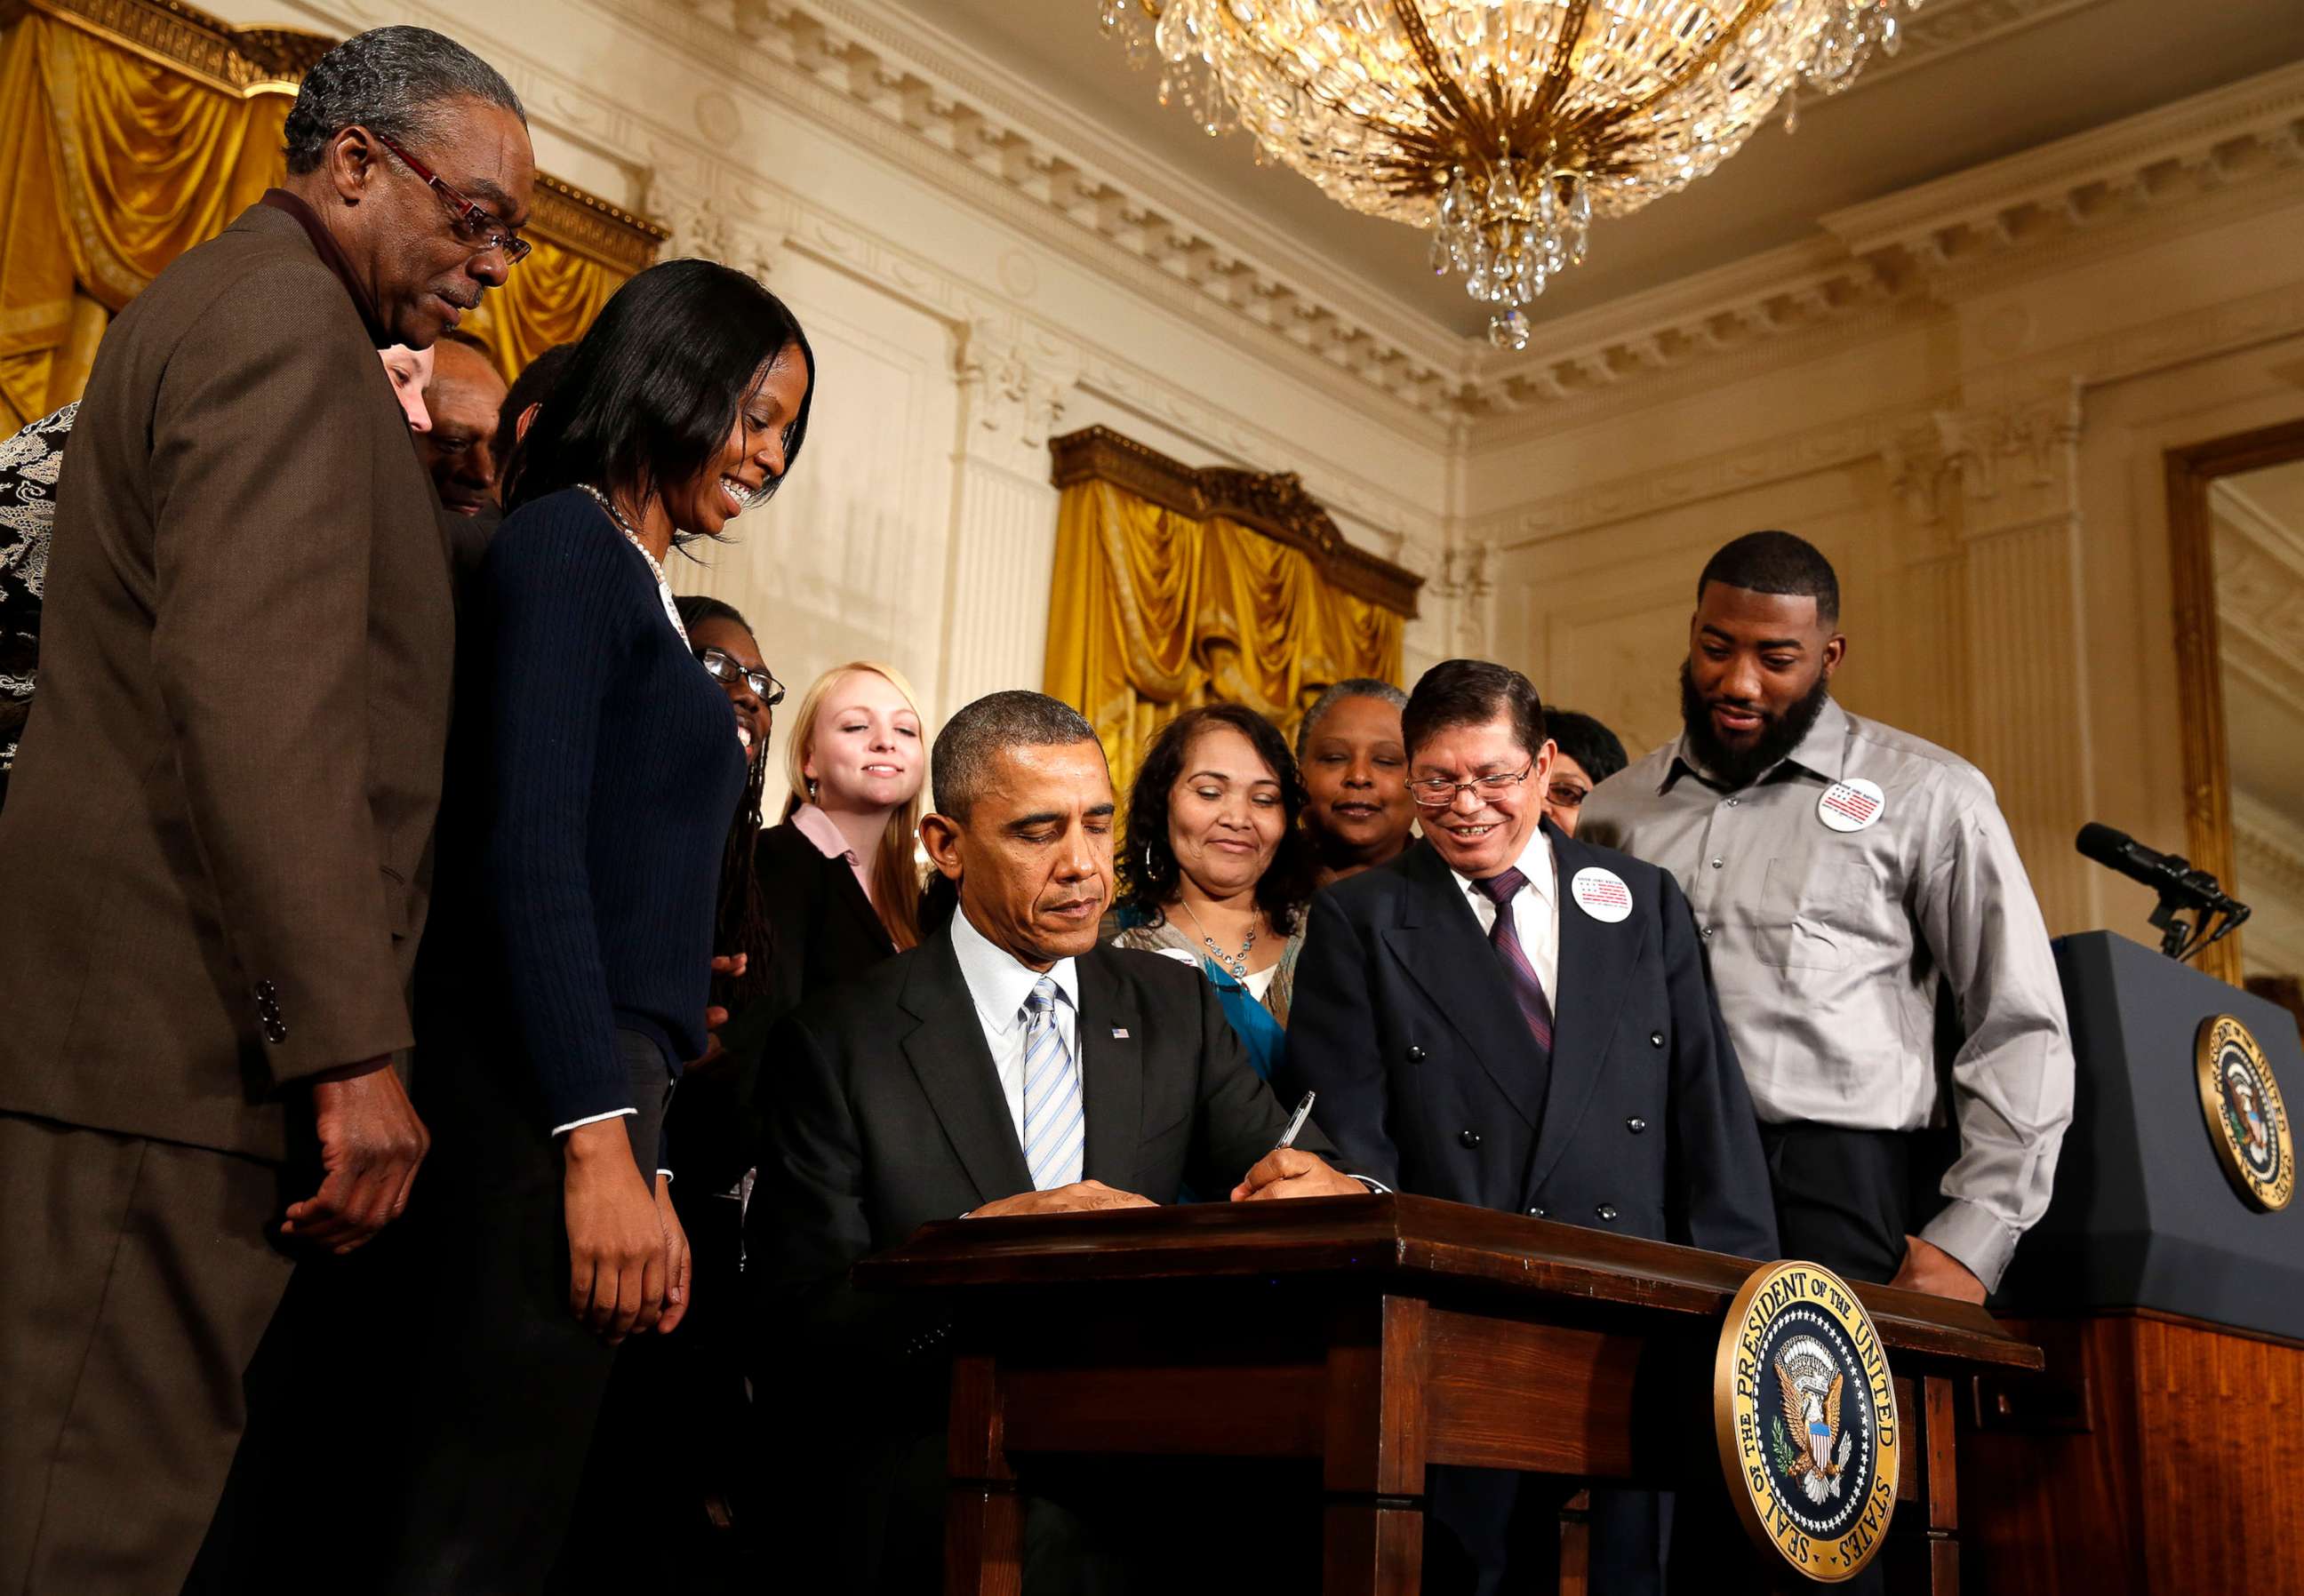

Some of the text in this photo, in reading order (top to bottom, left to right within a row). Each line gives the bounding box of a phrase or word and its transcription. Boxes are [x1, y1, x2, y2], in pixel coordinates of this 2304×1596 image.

[1737, 1273, 1894, 1567] SEAL OF THE PRESIDENT OF THE UNITED STATES
